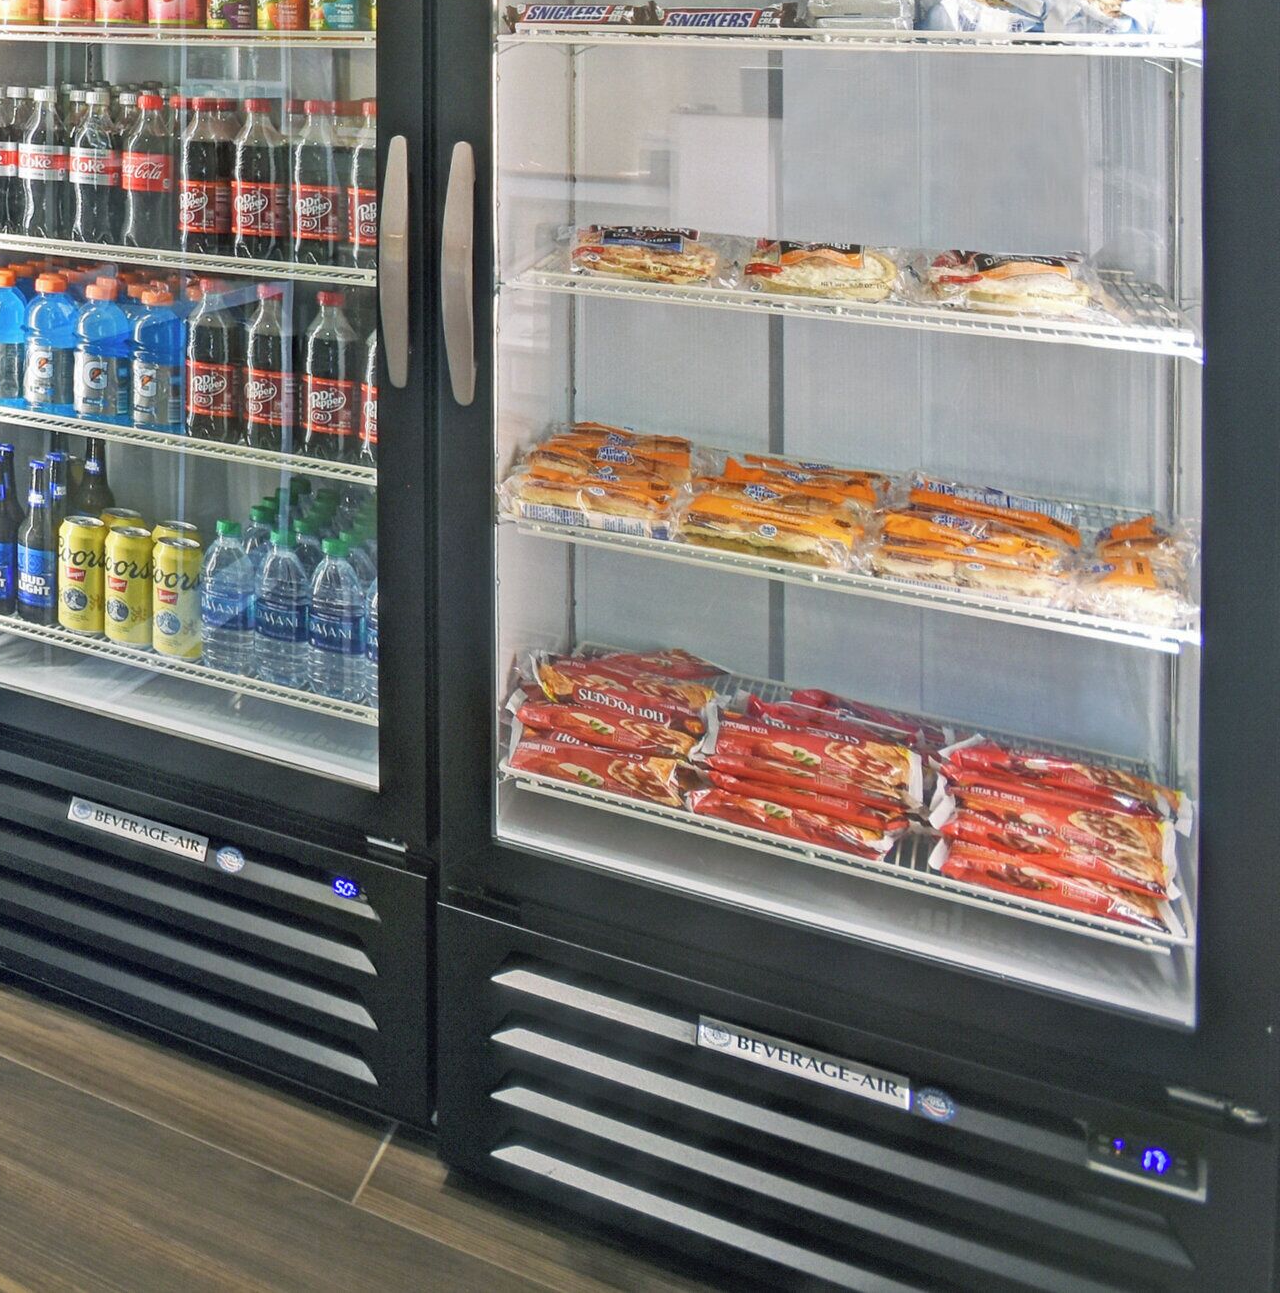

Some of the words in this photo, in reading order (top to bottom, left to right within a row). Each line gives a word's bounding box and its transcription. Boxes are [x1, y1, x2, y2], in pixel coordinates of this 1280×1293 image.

[527, 6, 607, 21] SNICKERS
[666, 12, 753, 28] SNICKERS
[18, 153, 52, 169] Coke
[71, 158, 106, 173] Coke
[21, 573, 46, 586] BUD
[18, 581, 51, 596] LIGHT
[257, 608, 299, 628] DASANI
[310, 621, 352, 640] DASANI
[93, 809, 202, 854] BEVERAGE-AIR
[736, 1034, 900, 1098] BEVERAGE-AIR
